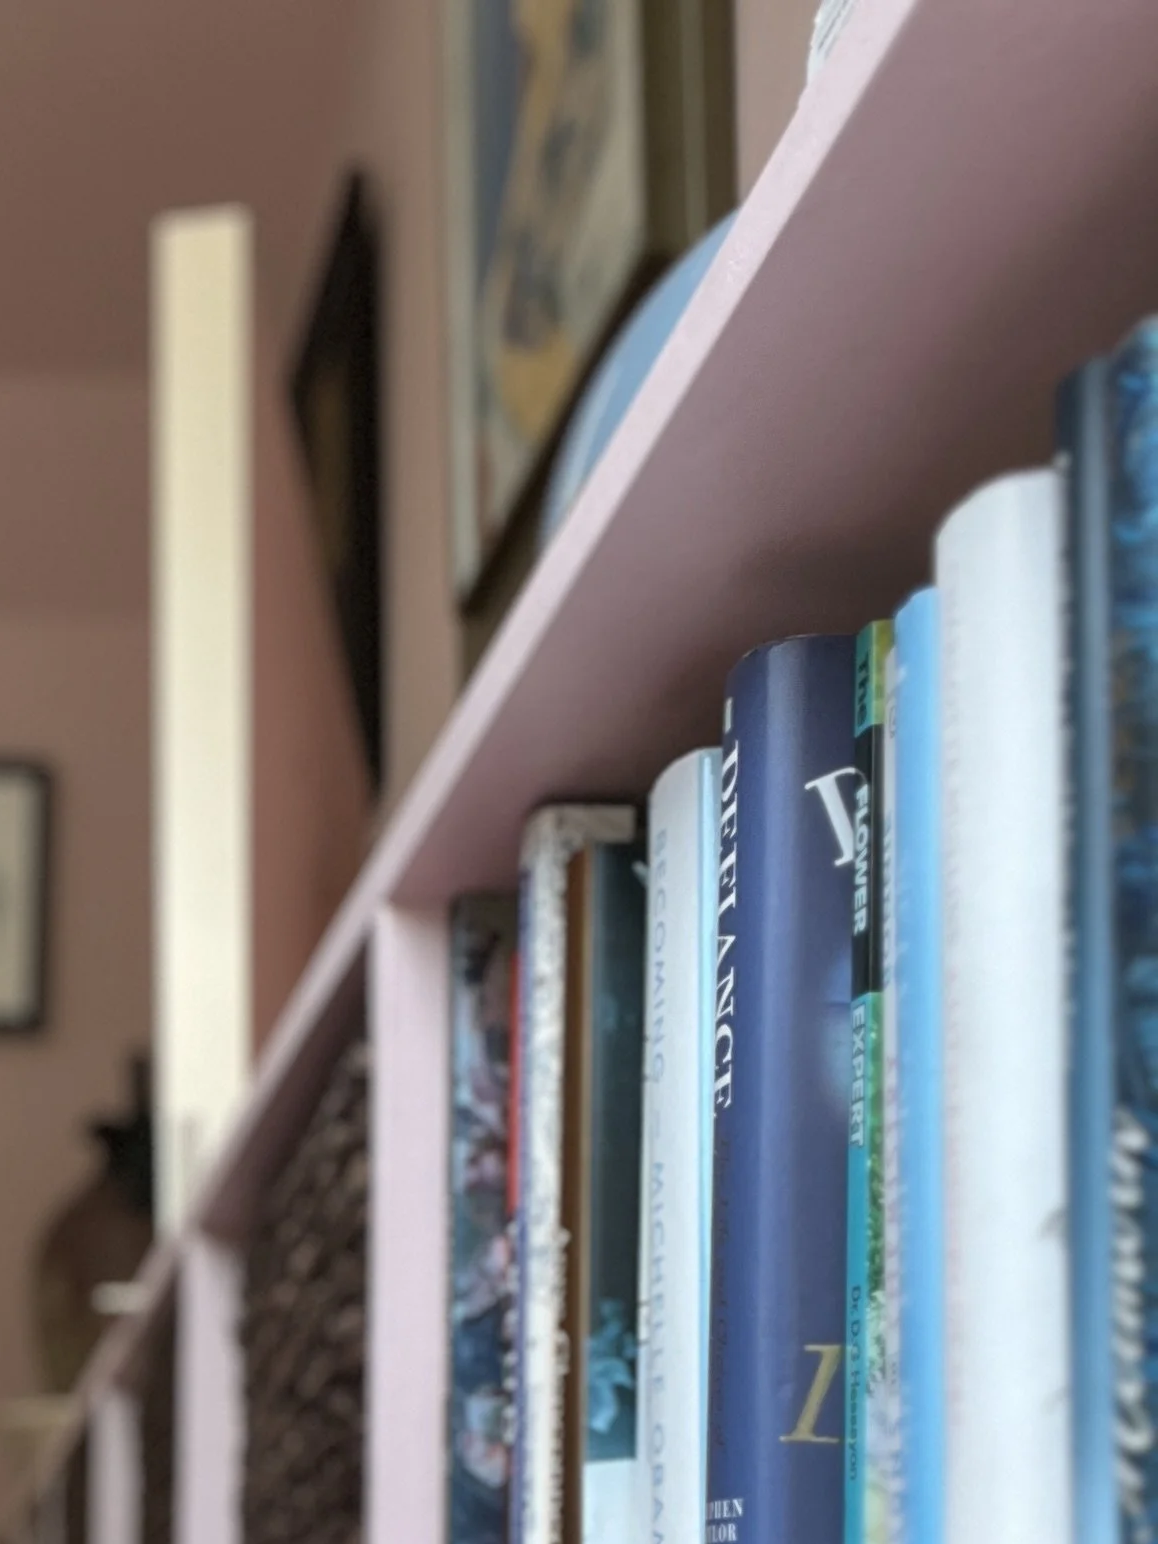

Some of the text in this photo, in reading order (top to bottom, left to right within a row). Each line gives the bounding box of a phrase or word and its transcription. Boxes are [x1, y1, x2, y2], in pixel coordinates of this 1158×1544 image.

[653, 830, 668, 1084] BECOMING
[849, 654, 870, 1147] The FLOWER EXPERT
[651, 1161, 665, 1392] MICHELLE
[850, 1285, 862, 1316] Dr.
[707, 1498, 744, 1520] PHEN
